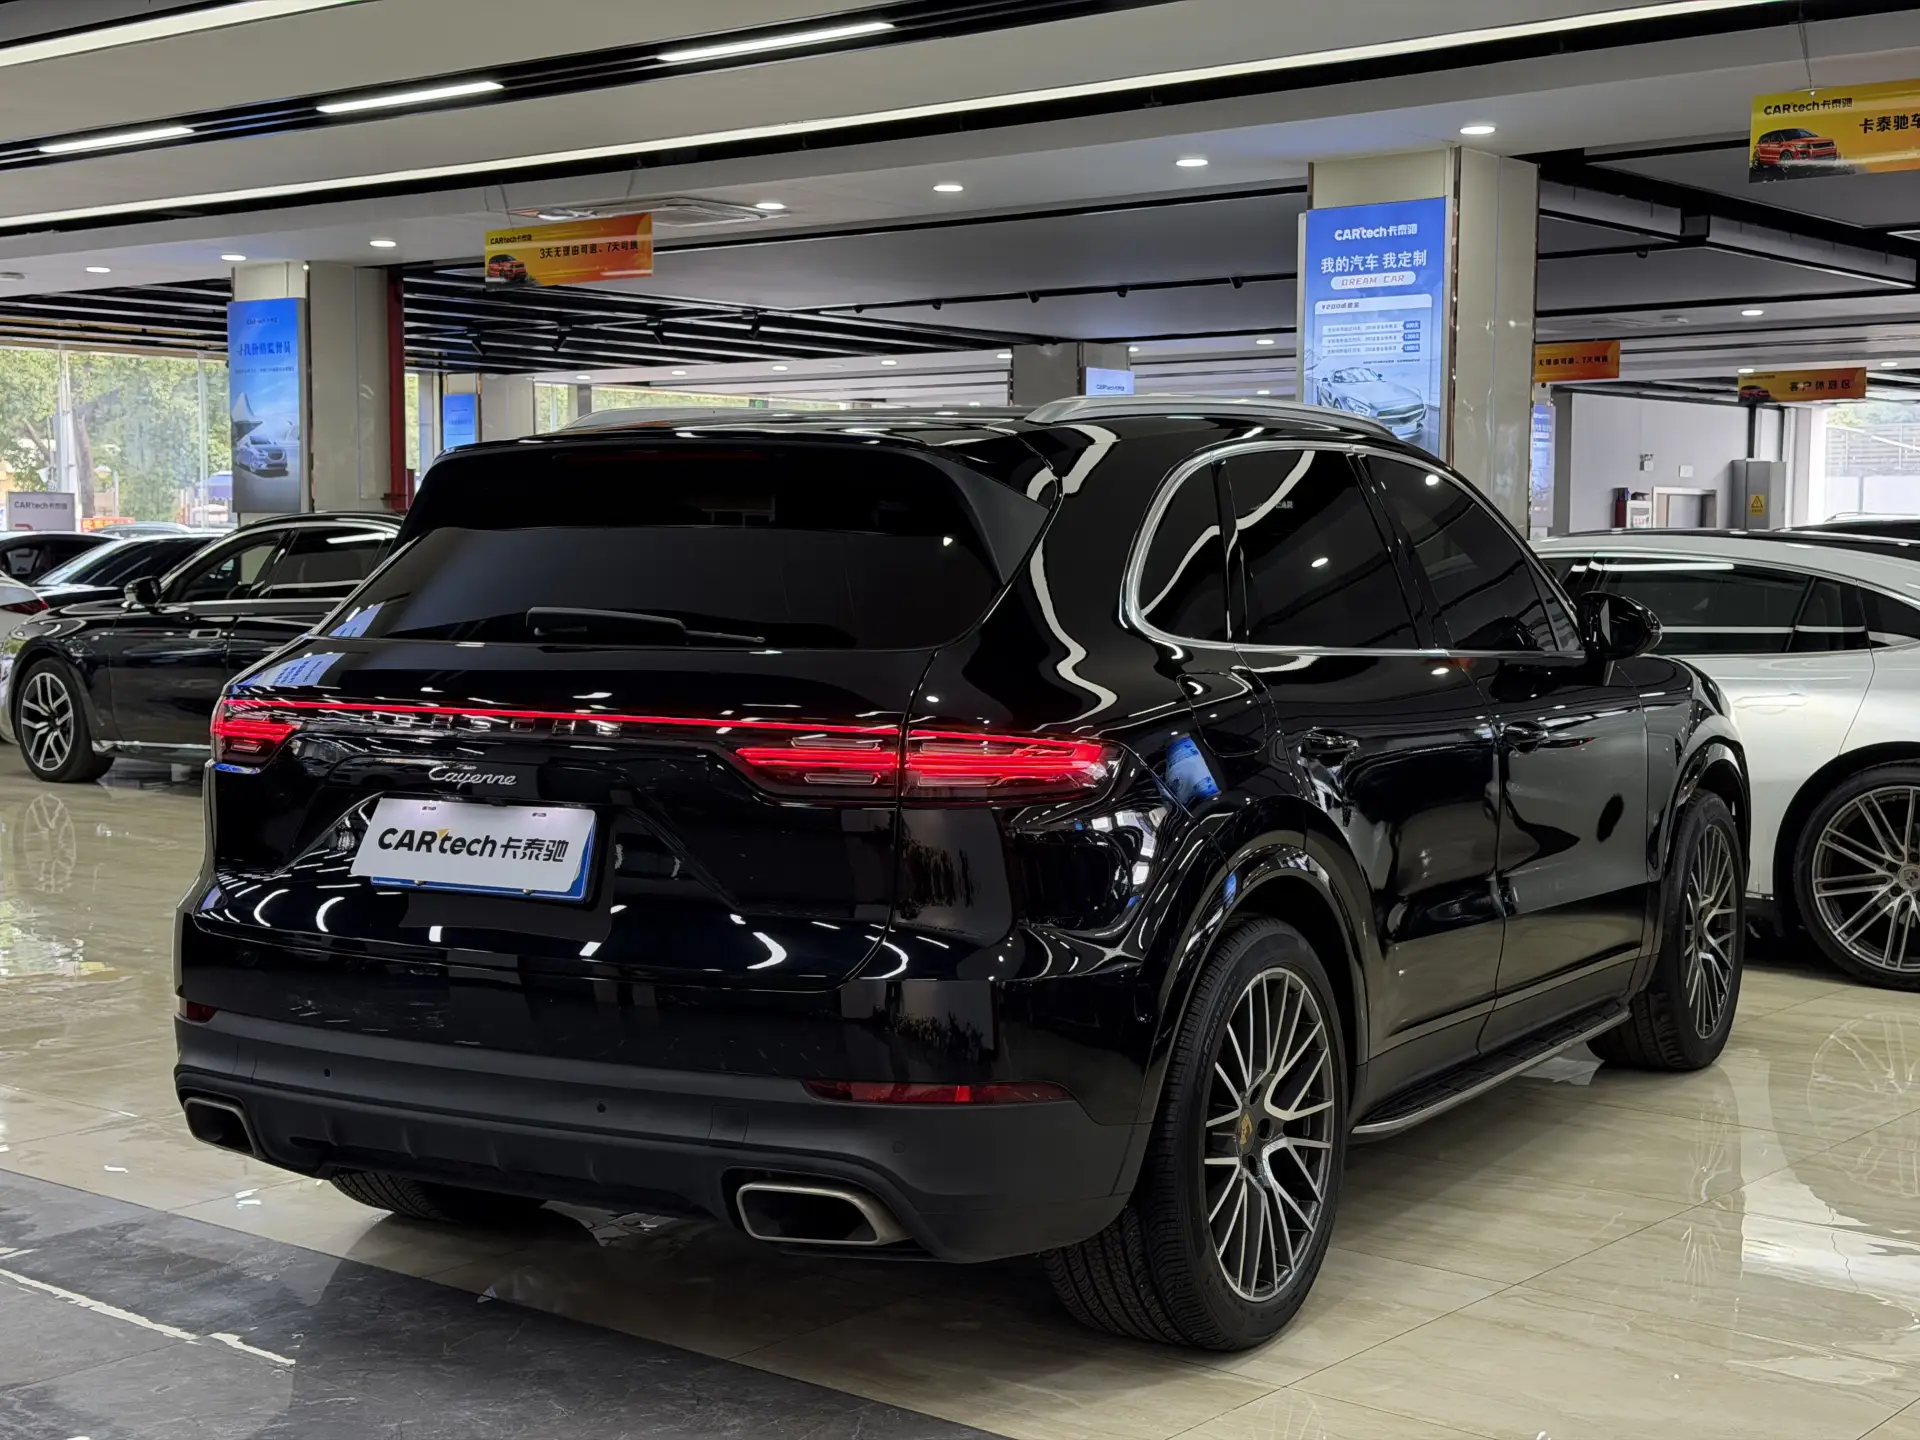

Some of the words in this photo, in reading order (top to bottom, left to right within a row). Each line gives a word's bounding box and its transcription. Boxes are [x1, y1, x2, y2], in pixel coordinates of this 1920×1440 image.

[1321, 254, 1379, 274] 我的汽车
[1382, 249, 1427, 269] 我定制
[1341, 277, 1377, 286] DREAM
[1383, 274, 1405, 283] CAR
[428, 764, 517, 789] Cayenne
